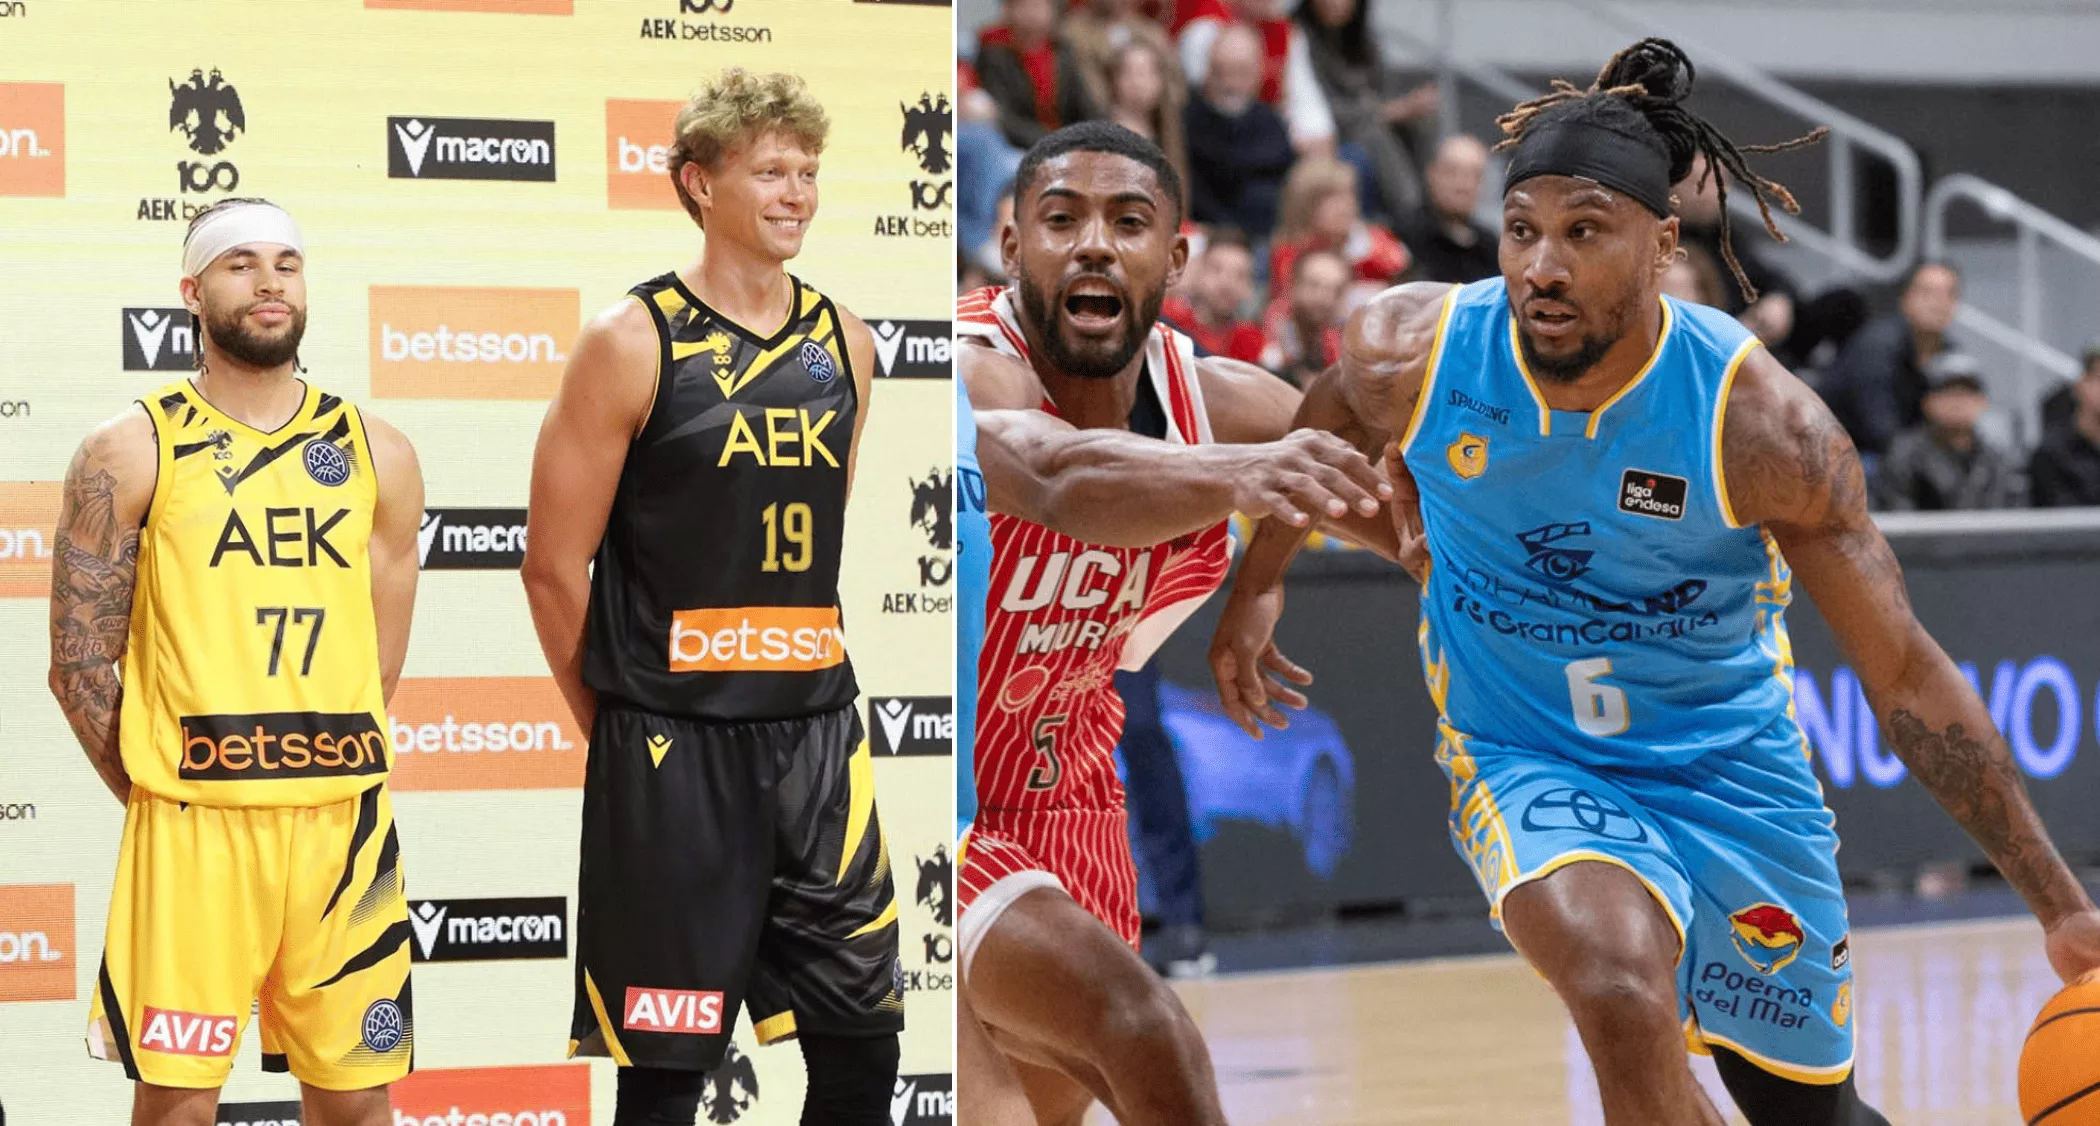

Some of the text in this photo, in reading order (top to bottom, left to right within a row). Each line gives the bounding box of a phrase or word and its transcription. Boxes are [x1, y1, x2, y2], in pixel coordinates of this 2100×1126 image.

[640, 18, 772, 42] AEK betsson
[436, 136, 550, 164] macron
[177, 161, 239, 193] 100
[137, 199, 176, 220] AEK
[875, 216, 952, 237] AEK bet
[1448, 388, 1511, 425] SPALDING
[717, 408, 841, 468] AEK
[1624, 497, 1680, 515] endesa
[1626, 482, 1652, 498] liga
[209, 507, 352, 569] AEK
[761, 501, 814, 573] 19
[1000, 549, 1151, 615] UCA
[882, 593, 917, 614] AEK
[255, 606, 327, 677] 77
[1564, 657, 1631, 737] 6
[181, 725, 388, 771] betsson
[1026, 713, 1070, 791] 5
[448, 914, 562, 944] macron
[1702, 962, 1812, 1007] Poema
[626, 992, 721, 1030] AVIS
[1696, 987, 1811, 1029] del Mar
[141, 1013, 236, 1053] AVIS
